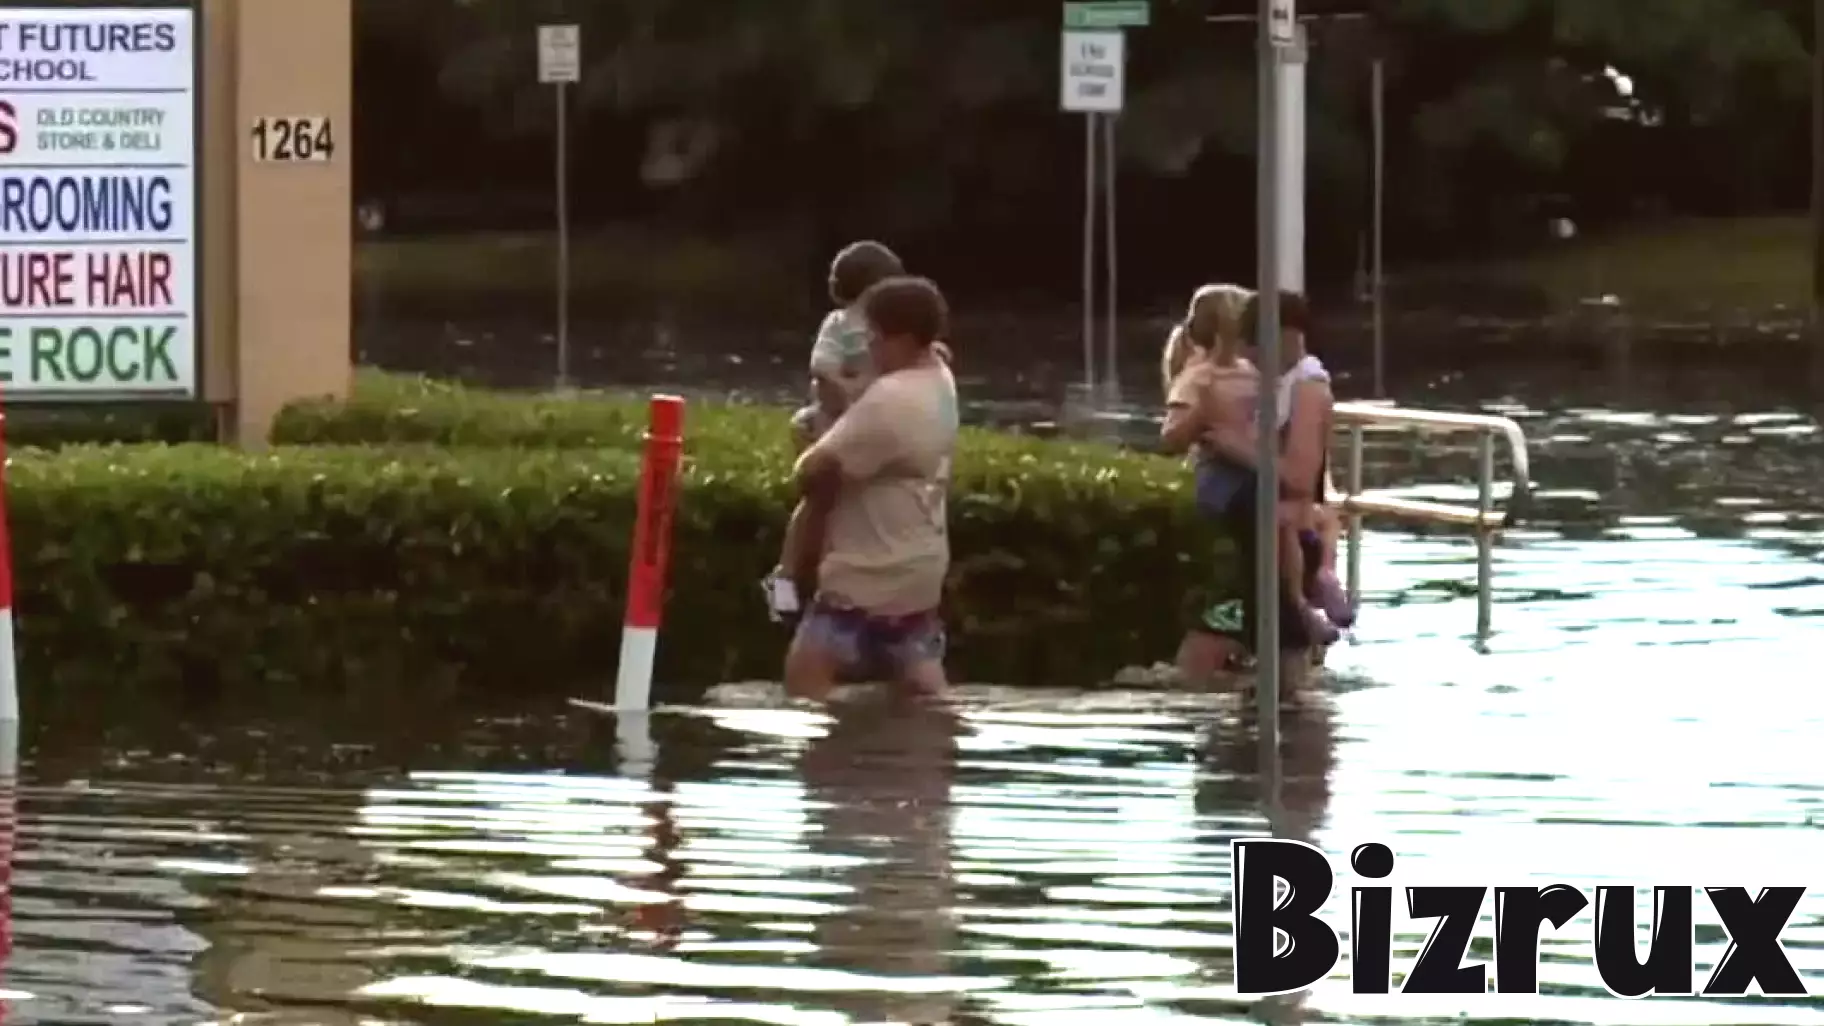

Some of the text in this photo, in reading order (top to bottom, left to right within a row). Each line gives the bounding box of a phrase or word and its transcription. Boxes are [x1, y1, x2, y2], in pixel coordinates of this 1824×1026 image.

[19, 23, 175, 52] FUTURES
[37, 108, 166, 126] OLD COUNTRY
[252, 117, 335, 161] 1264
[37, 131, 161, 150] STORE & DELI
[0, 177, 172, 232] ROOMING
[88, 252, 172, 306] HAIR
[30, 326, 178, 382] ROCK
